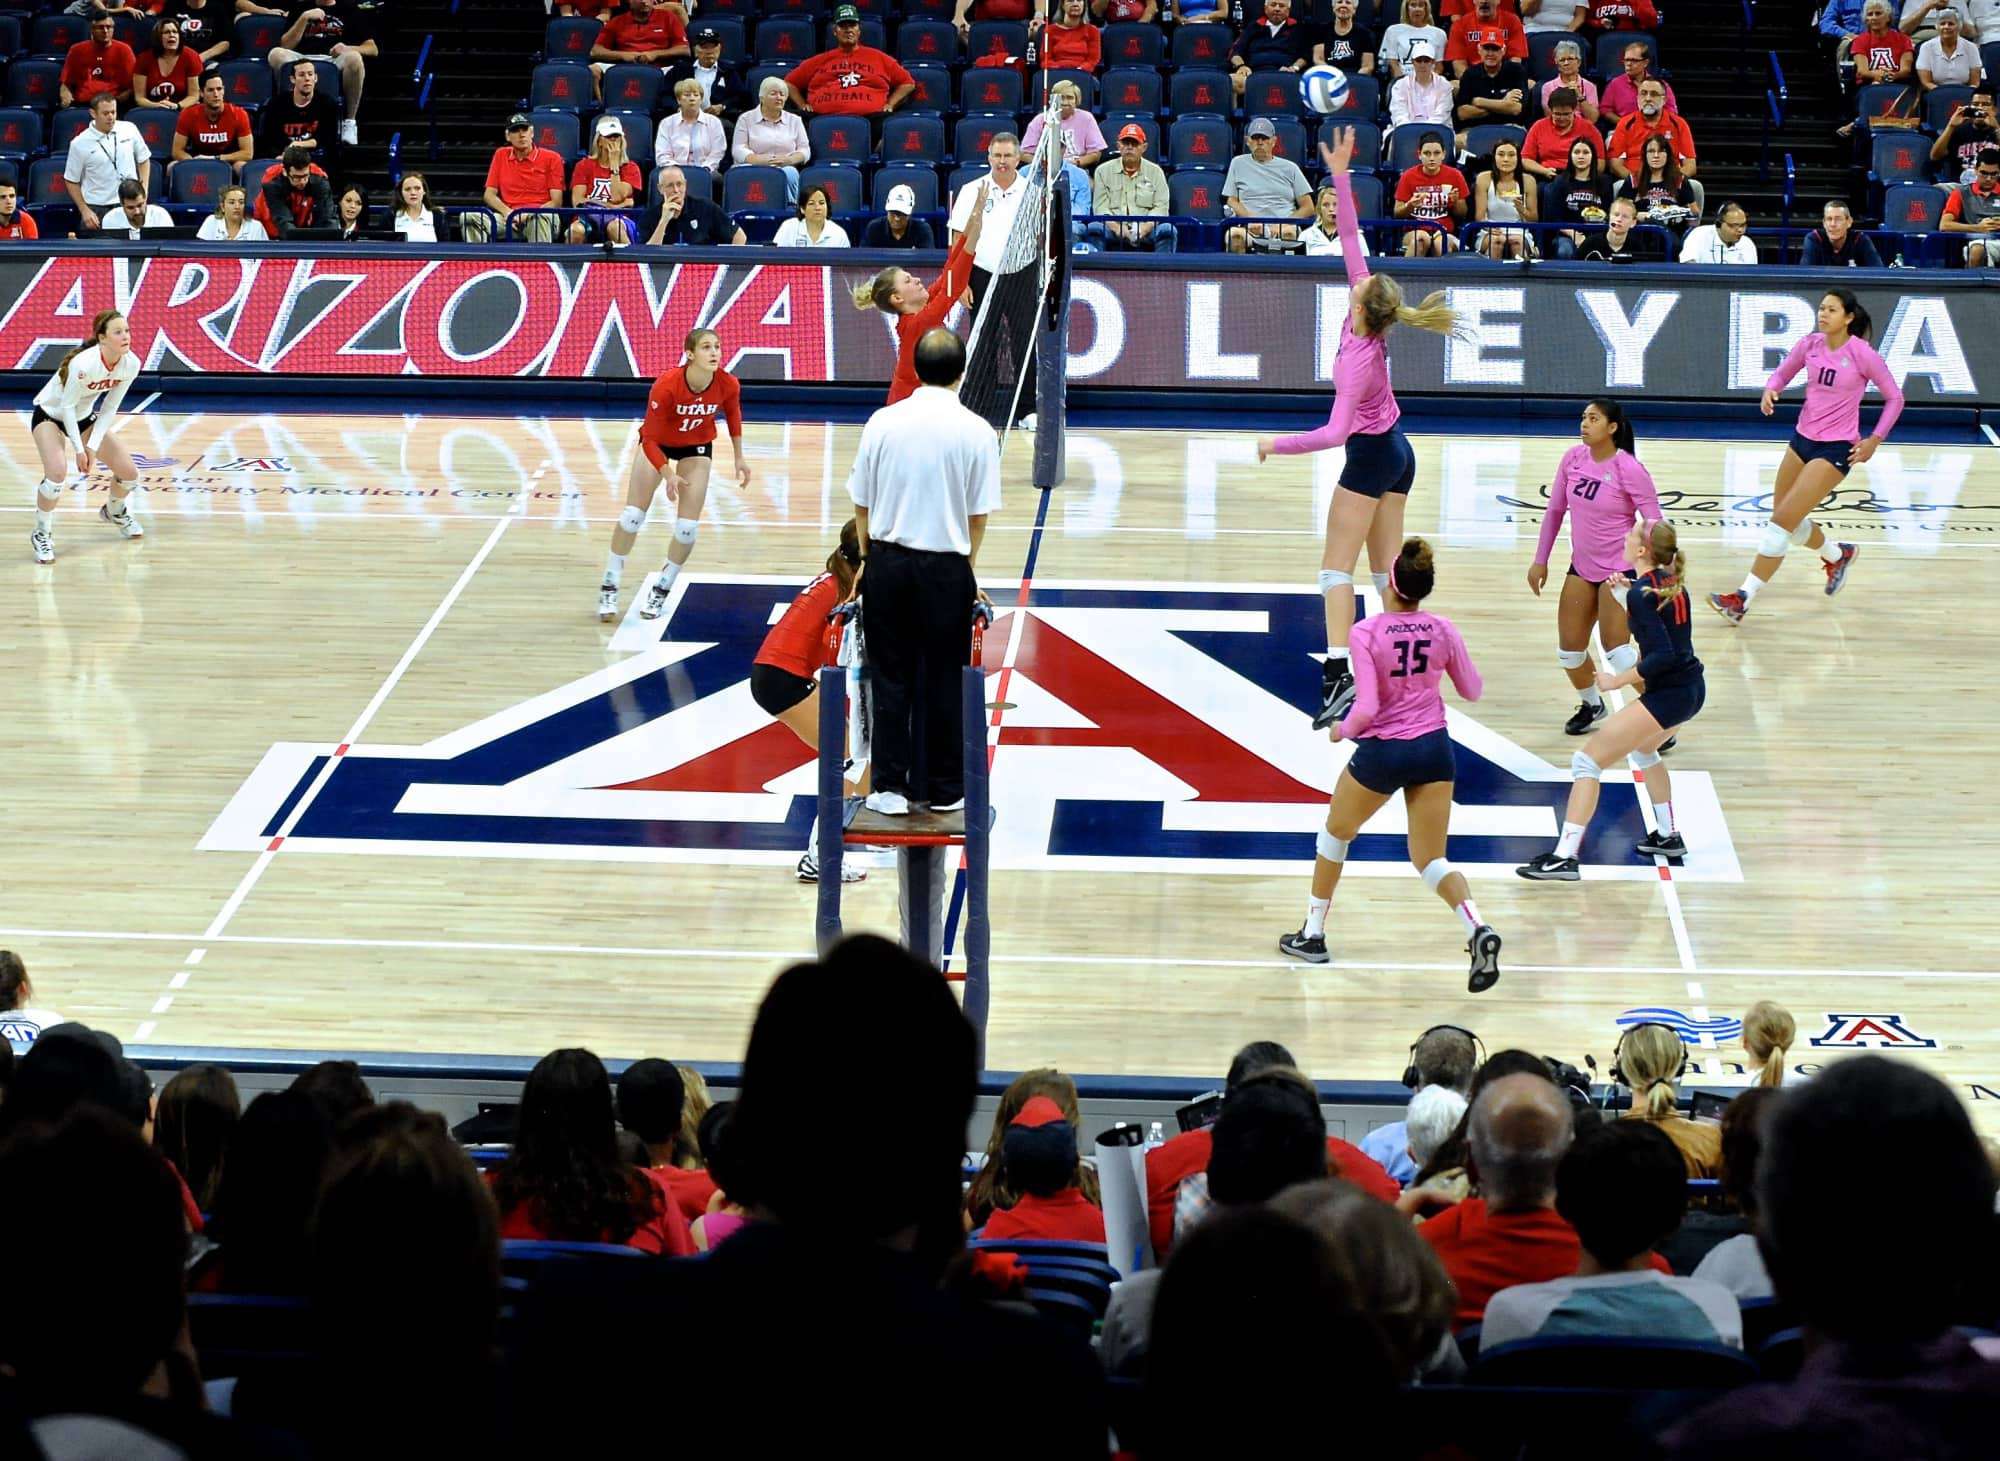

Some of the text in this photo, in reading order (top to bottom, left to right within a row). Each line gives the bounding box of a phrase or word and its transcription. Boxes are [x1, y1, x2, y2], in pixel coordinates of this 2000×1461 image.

[1869, 47, 1899, 71] A
[199, 132, 228, 144] UTAH
[0, 256, 1980, 396] ARIZONA OLLEYBA
[1817, 366, 1836, 387] 10
[676, 403, 719, 416] UTAH
[79, 474, 223, 484] Baner
[69, 483, 268, 496] Unversity
[279, 486, 440, 498] Medical
[1572, 477, 1602, 501] 20
[1815, 521, 1901, 530] lson
[1385, 623, 1433, 634] ARIZONA
[1390, 639, 1431, 678] 35
[1809, 1012, 1938, 1049] A
